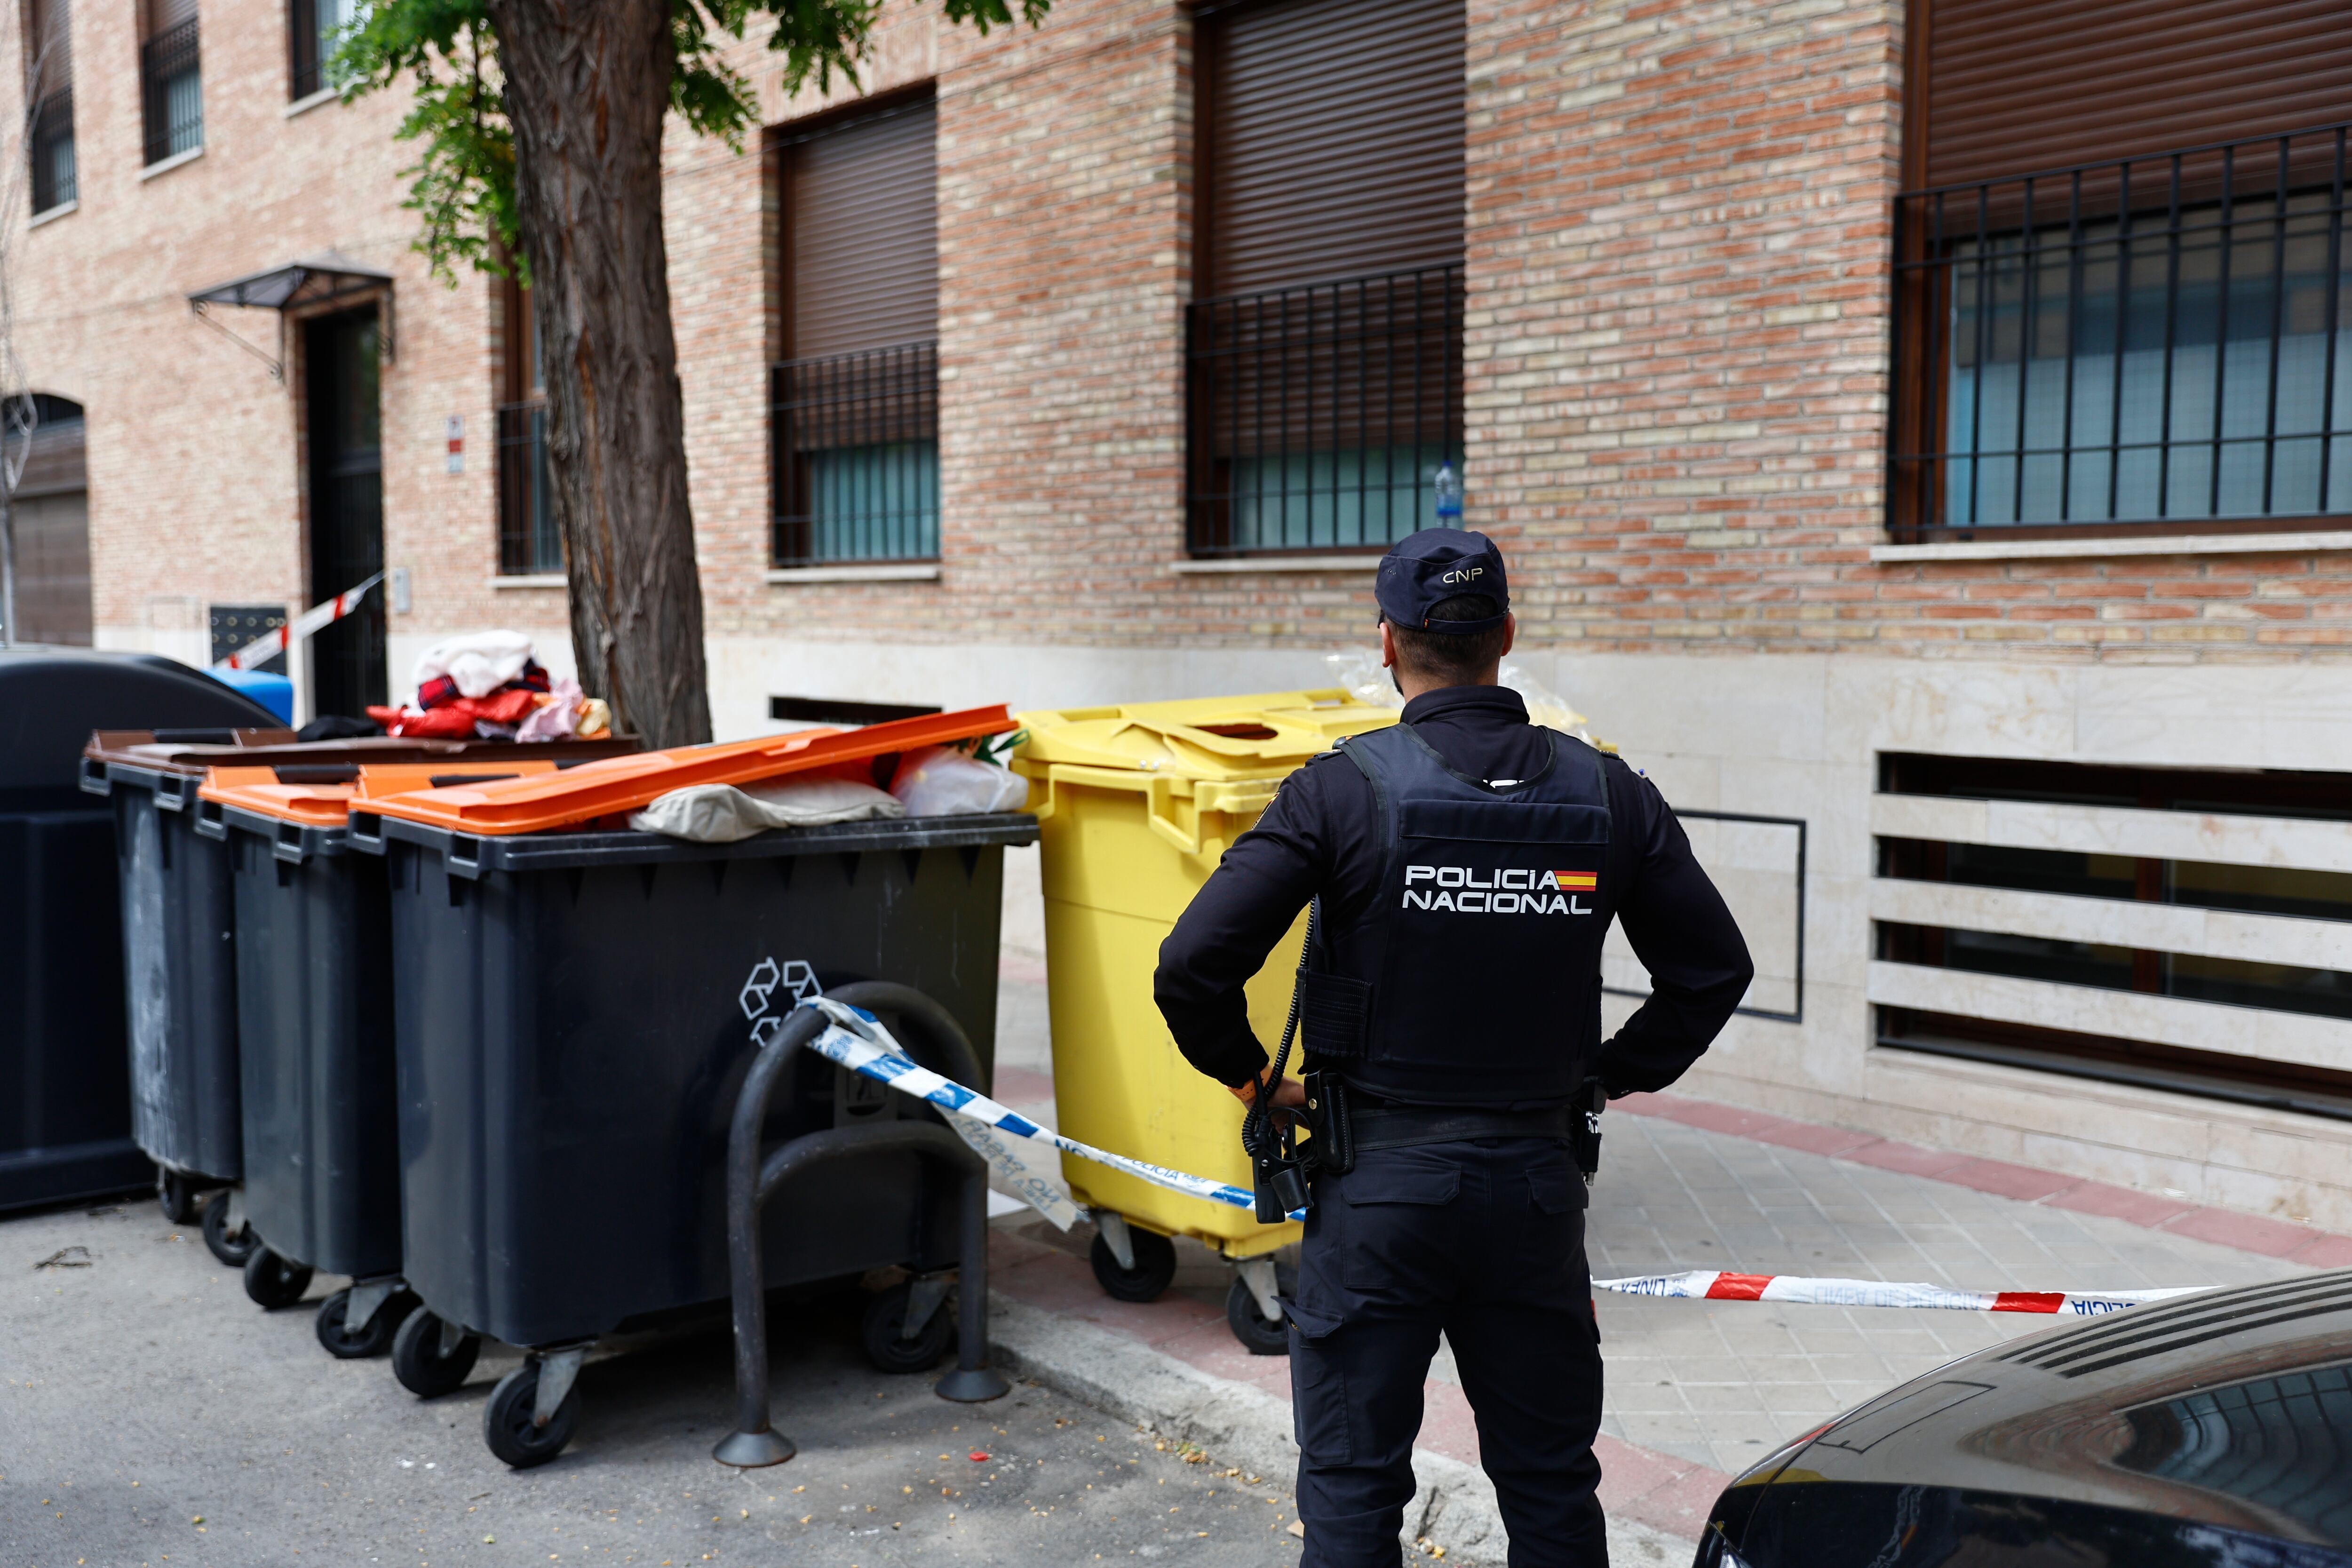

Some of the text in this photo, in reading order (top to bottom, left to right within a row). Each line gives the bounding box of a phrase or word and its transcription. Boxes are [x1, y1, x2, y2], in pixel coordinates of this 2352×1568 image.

[1443, 567, 1483, 583] CNP
[1402, 889, 1593, 915] NACIONAL
[1122, 1157, 1179, 1181] OLICIA
